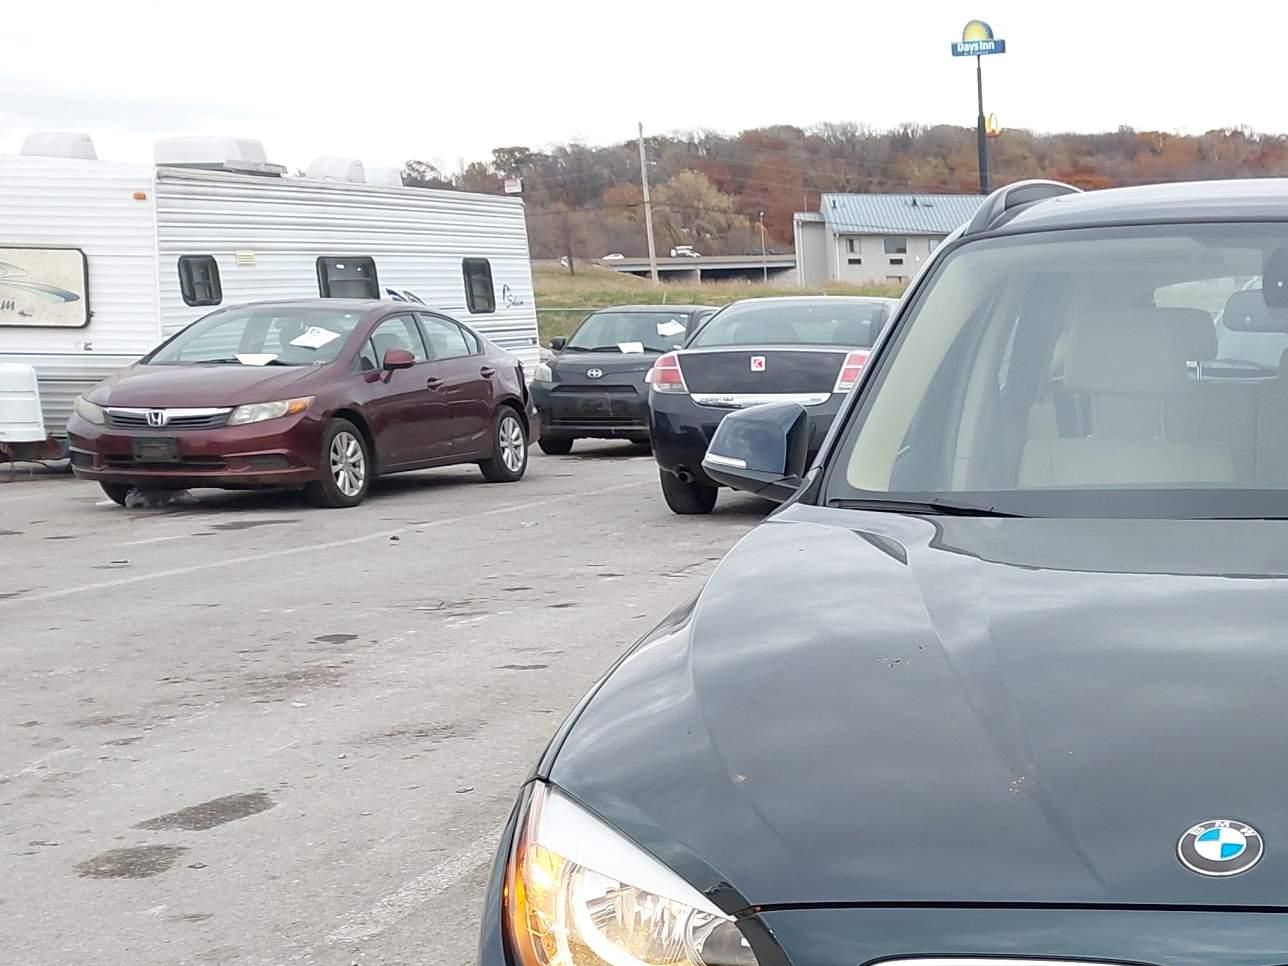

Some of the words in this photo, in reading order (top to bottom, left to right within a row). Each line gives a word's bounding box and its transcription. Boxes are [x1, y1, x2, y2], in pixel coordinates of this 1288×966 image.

[957, 42, 979, 54] Days
[979, 41, 995, 51] Inn
[1188, 821, 1258, 837] BMW
